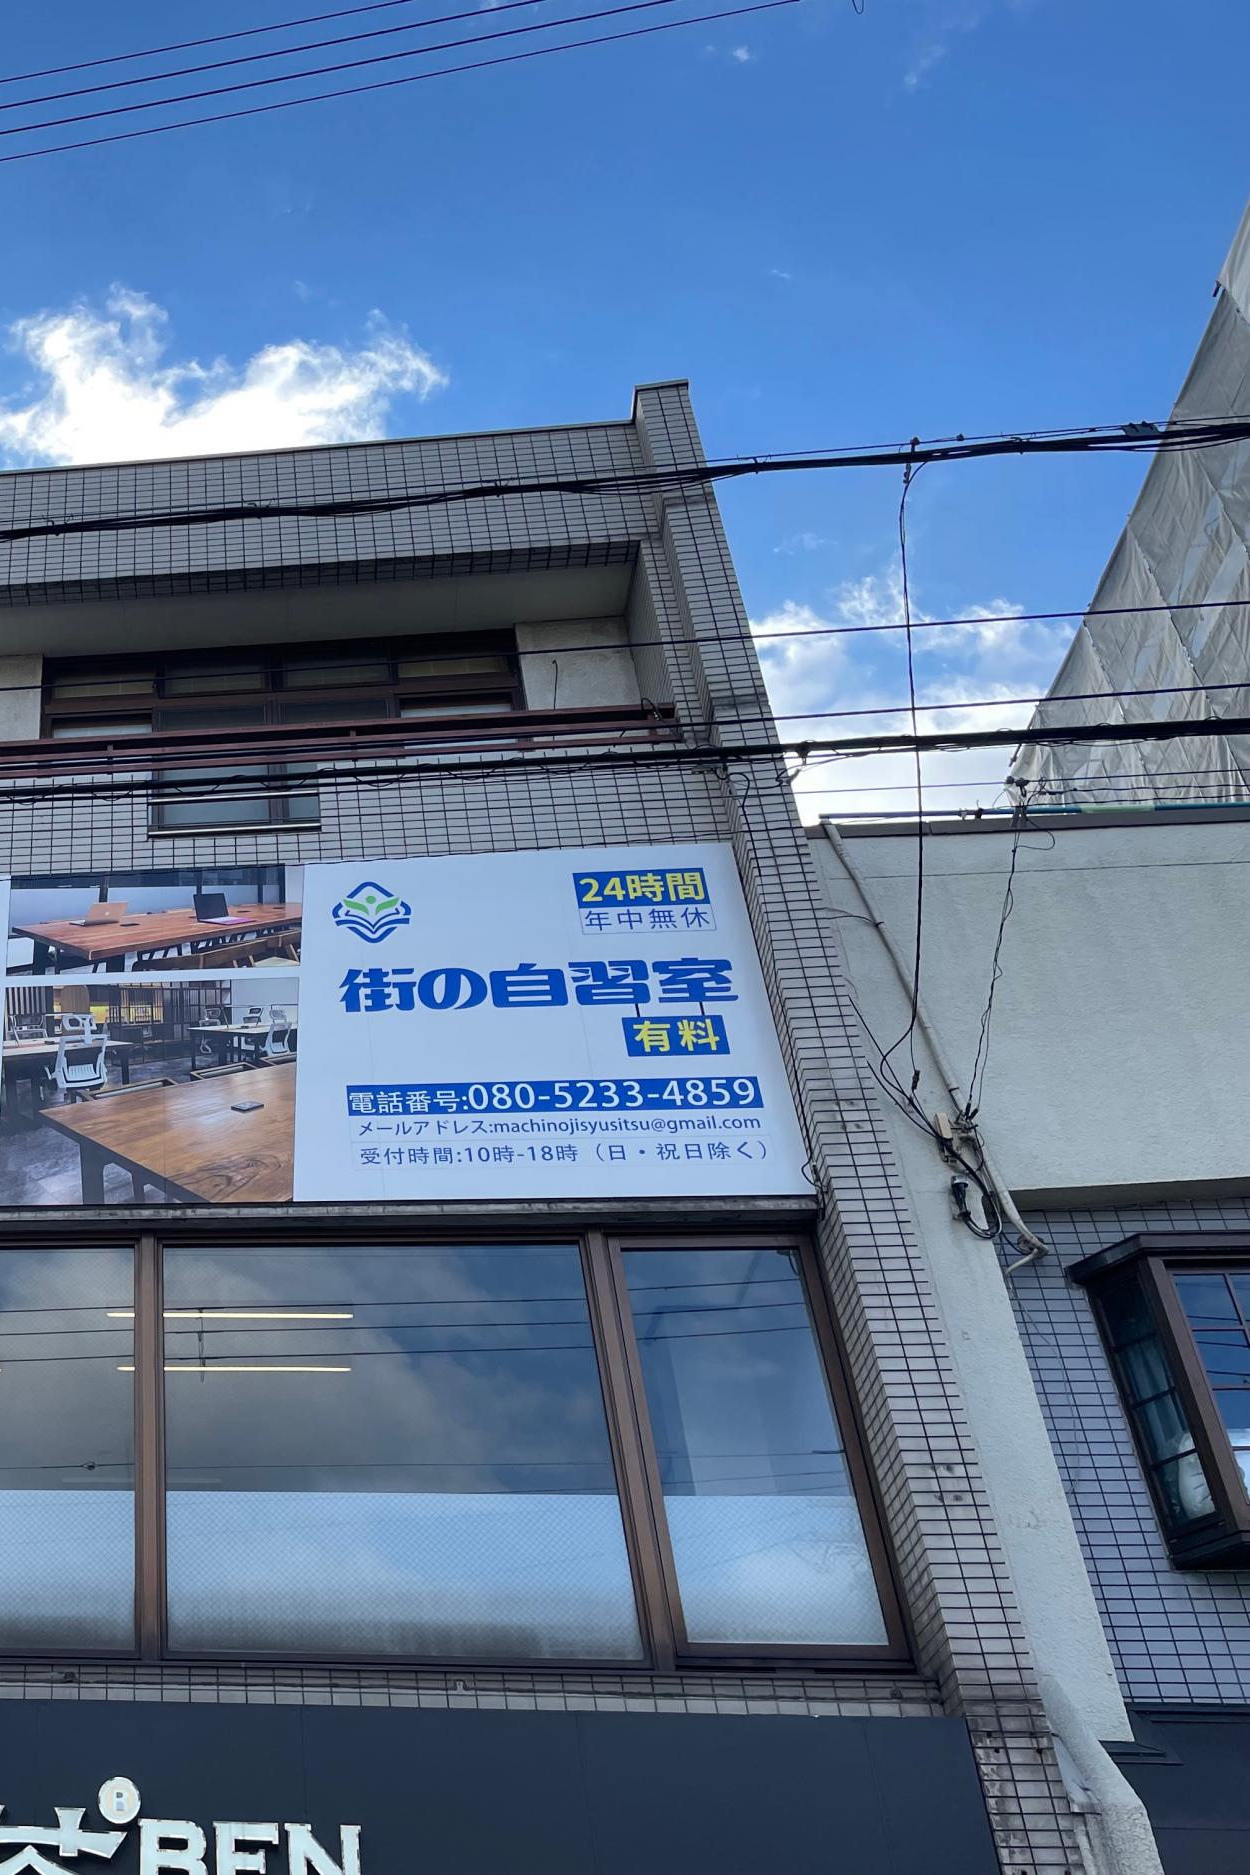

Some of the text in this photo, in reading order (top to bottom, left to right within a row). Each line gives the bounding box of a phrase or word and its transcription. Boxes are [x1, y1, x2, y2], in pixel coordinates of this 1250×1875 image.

[579, 872, 705, 902] 24時間
[585, 907, 710, 931] 年中無休
[339, 958, 738, 1012] 街の自習室
[633, 1019, 719, 1052] 有料
[349, 1079, 755, 1114] 電話番号:080-5233-4859
